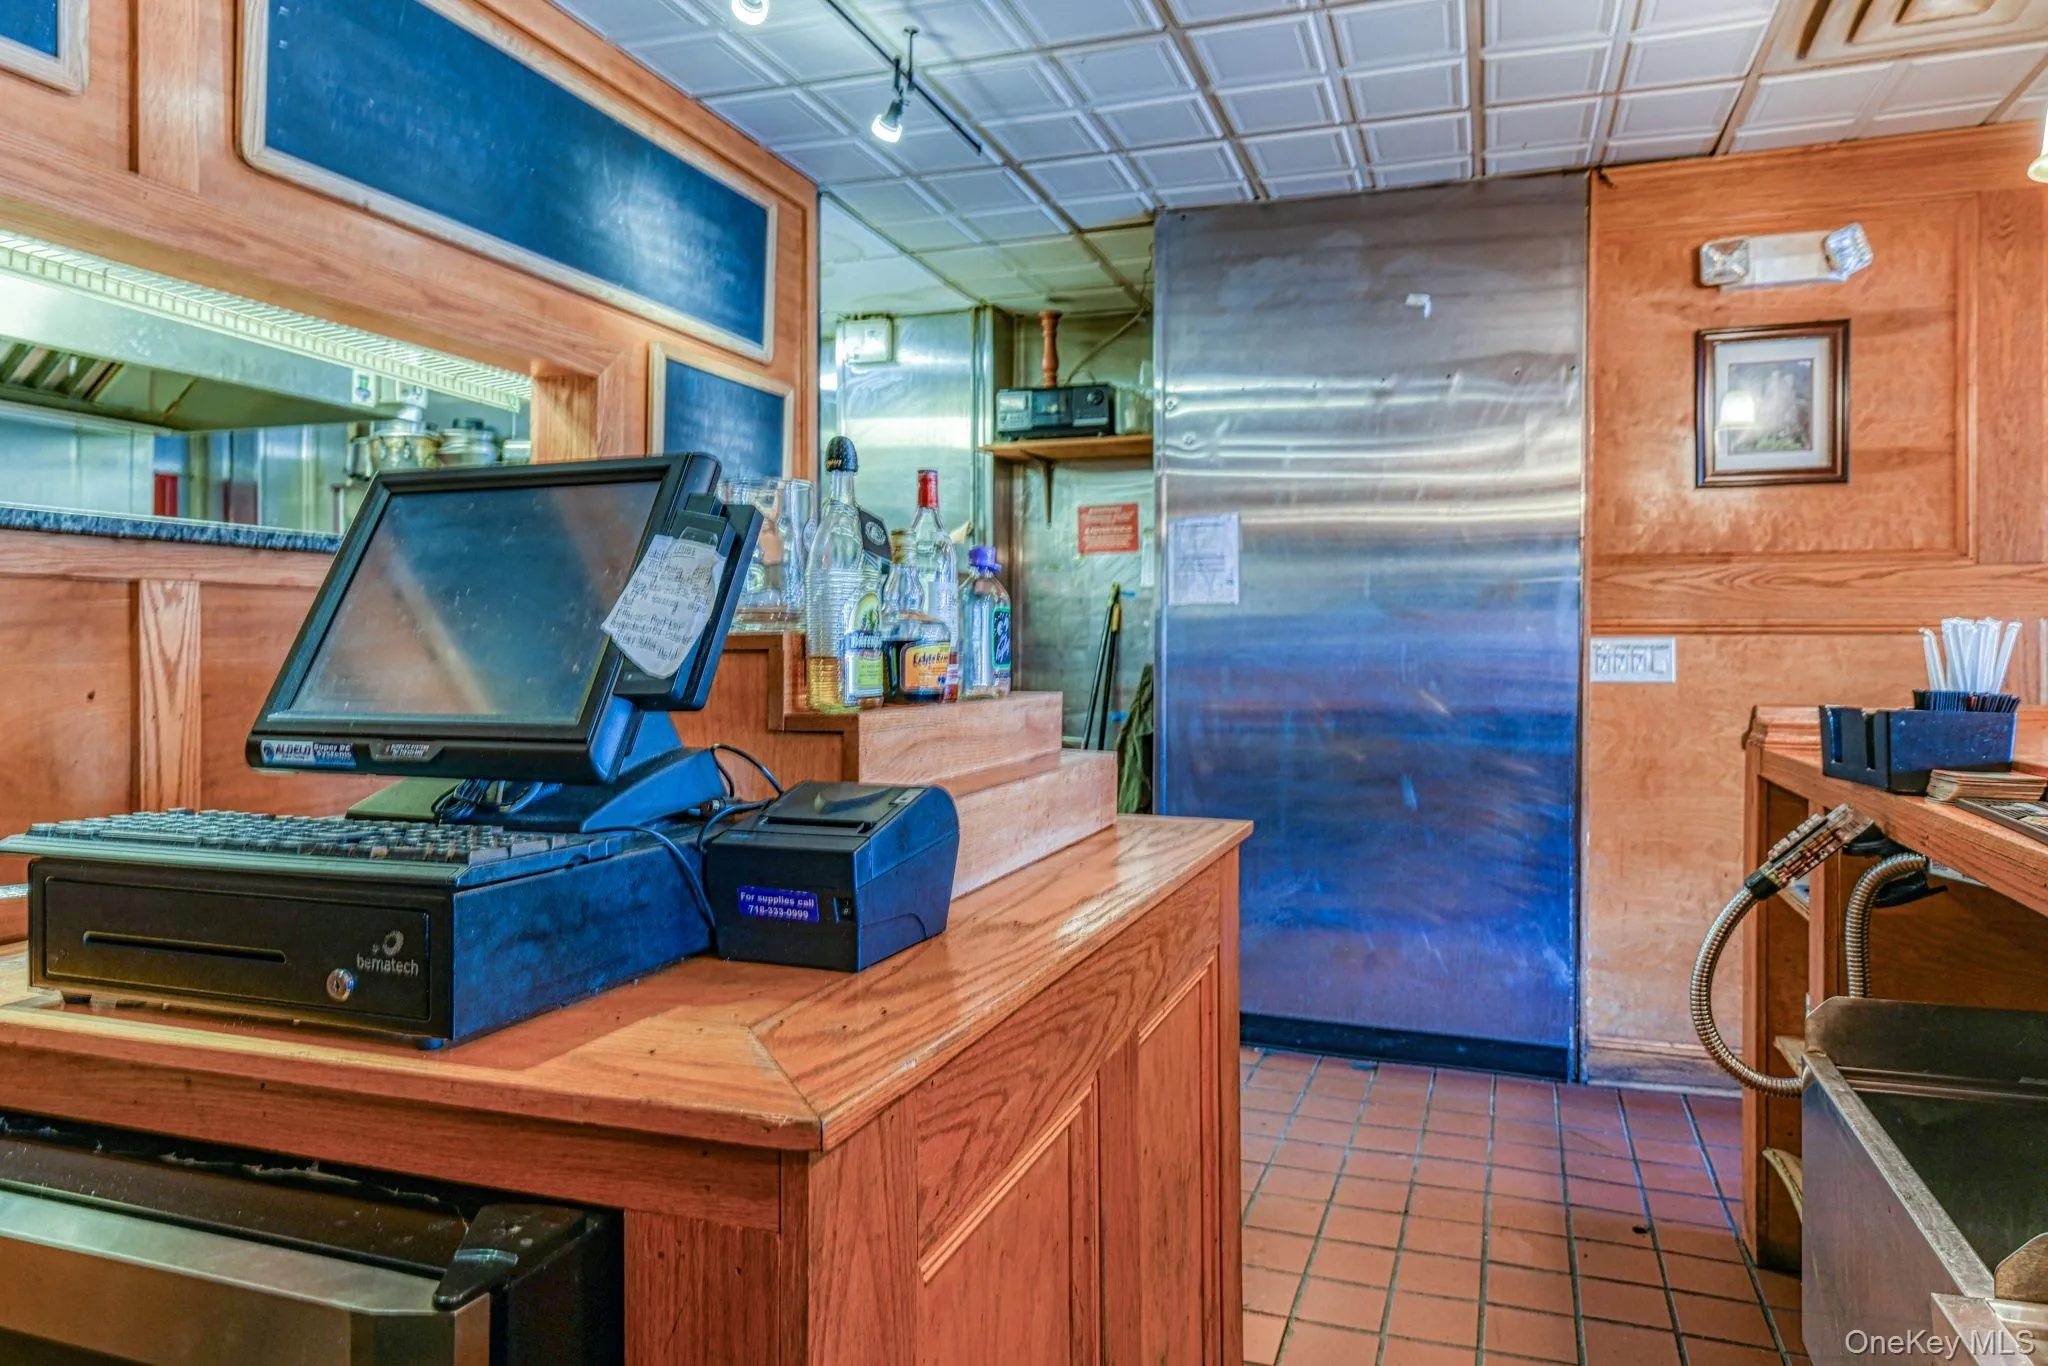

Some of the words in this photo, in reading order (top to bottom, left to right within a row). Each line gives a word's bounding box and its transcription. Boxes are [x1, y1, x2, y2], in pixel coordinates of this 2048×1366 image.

[740, 891, 756, 901] For
[757, 895, 795, 906] supplies
[797, 898, 815, 908] call
[356, 953, 419, 977] bematech
